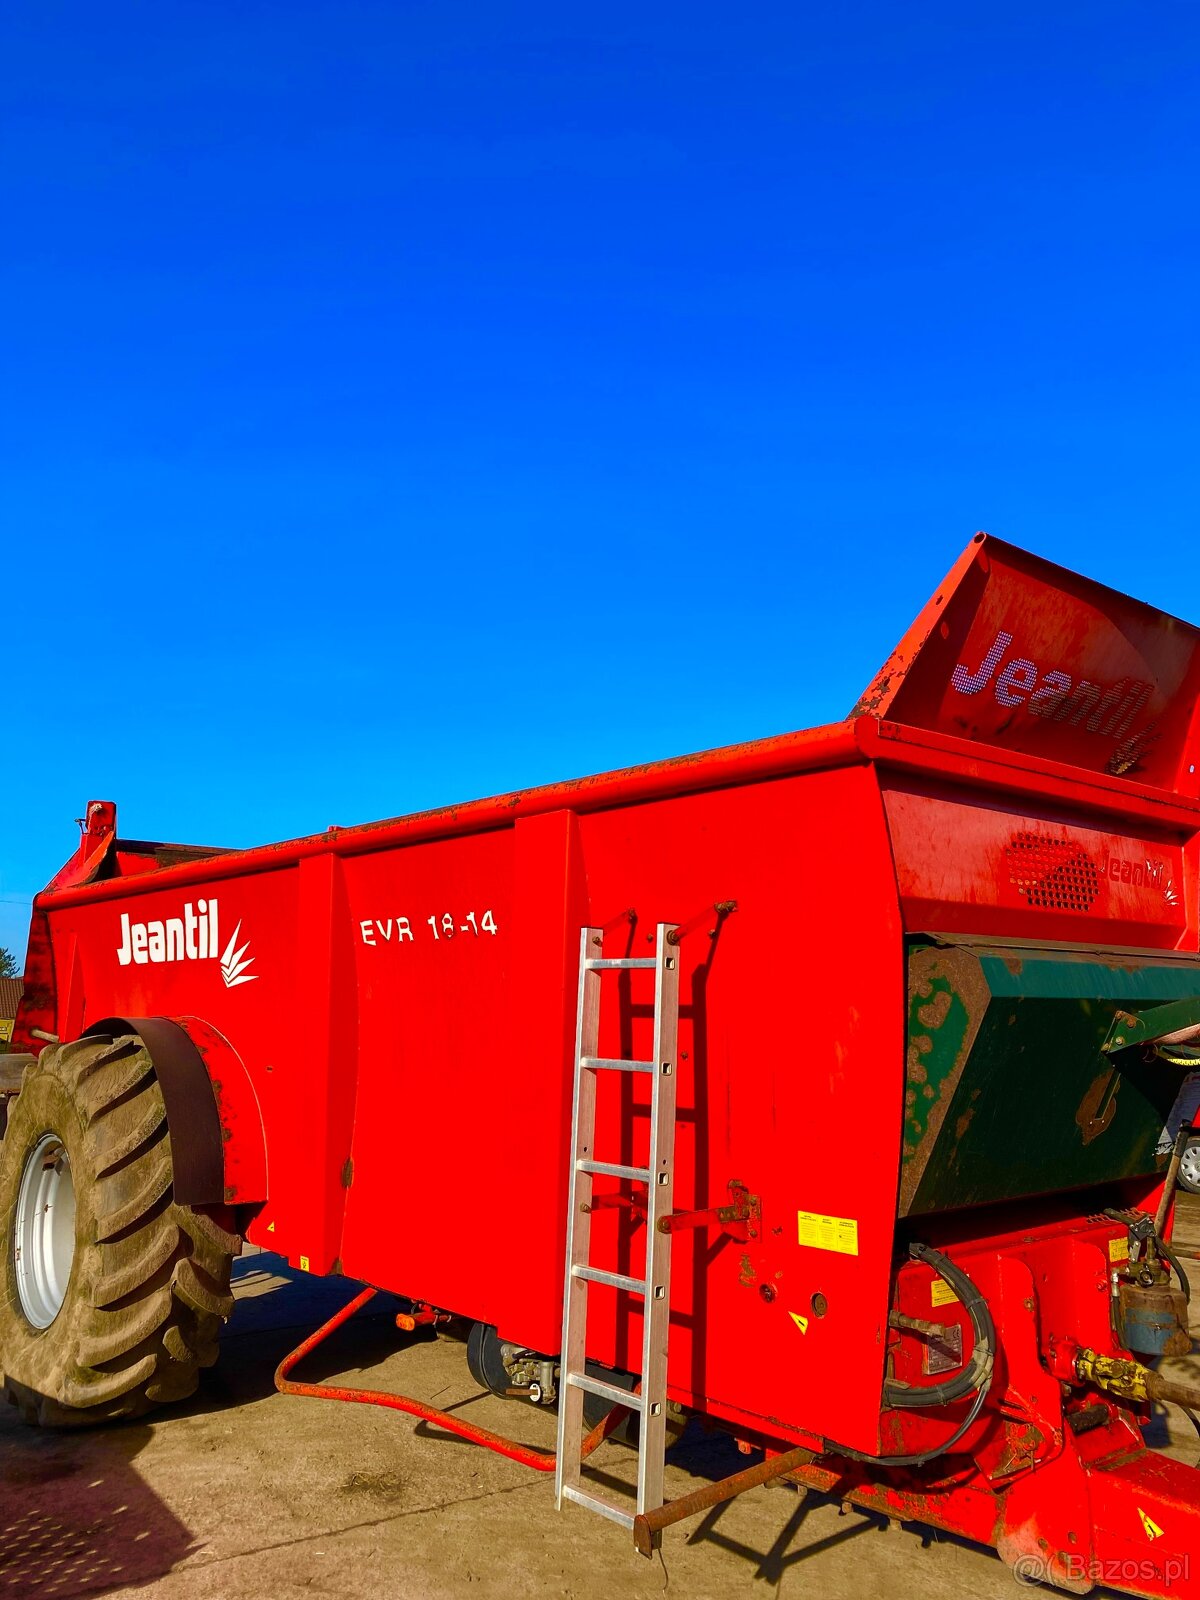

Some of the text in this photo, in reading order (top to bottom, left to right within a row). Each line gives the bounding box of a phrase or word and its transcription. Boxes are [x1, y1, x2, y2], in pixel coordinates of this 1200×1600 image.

[116, 899, 218, 965] Jeantil
[360, 910, 498, 946] EVR 18-14
